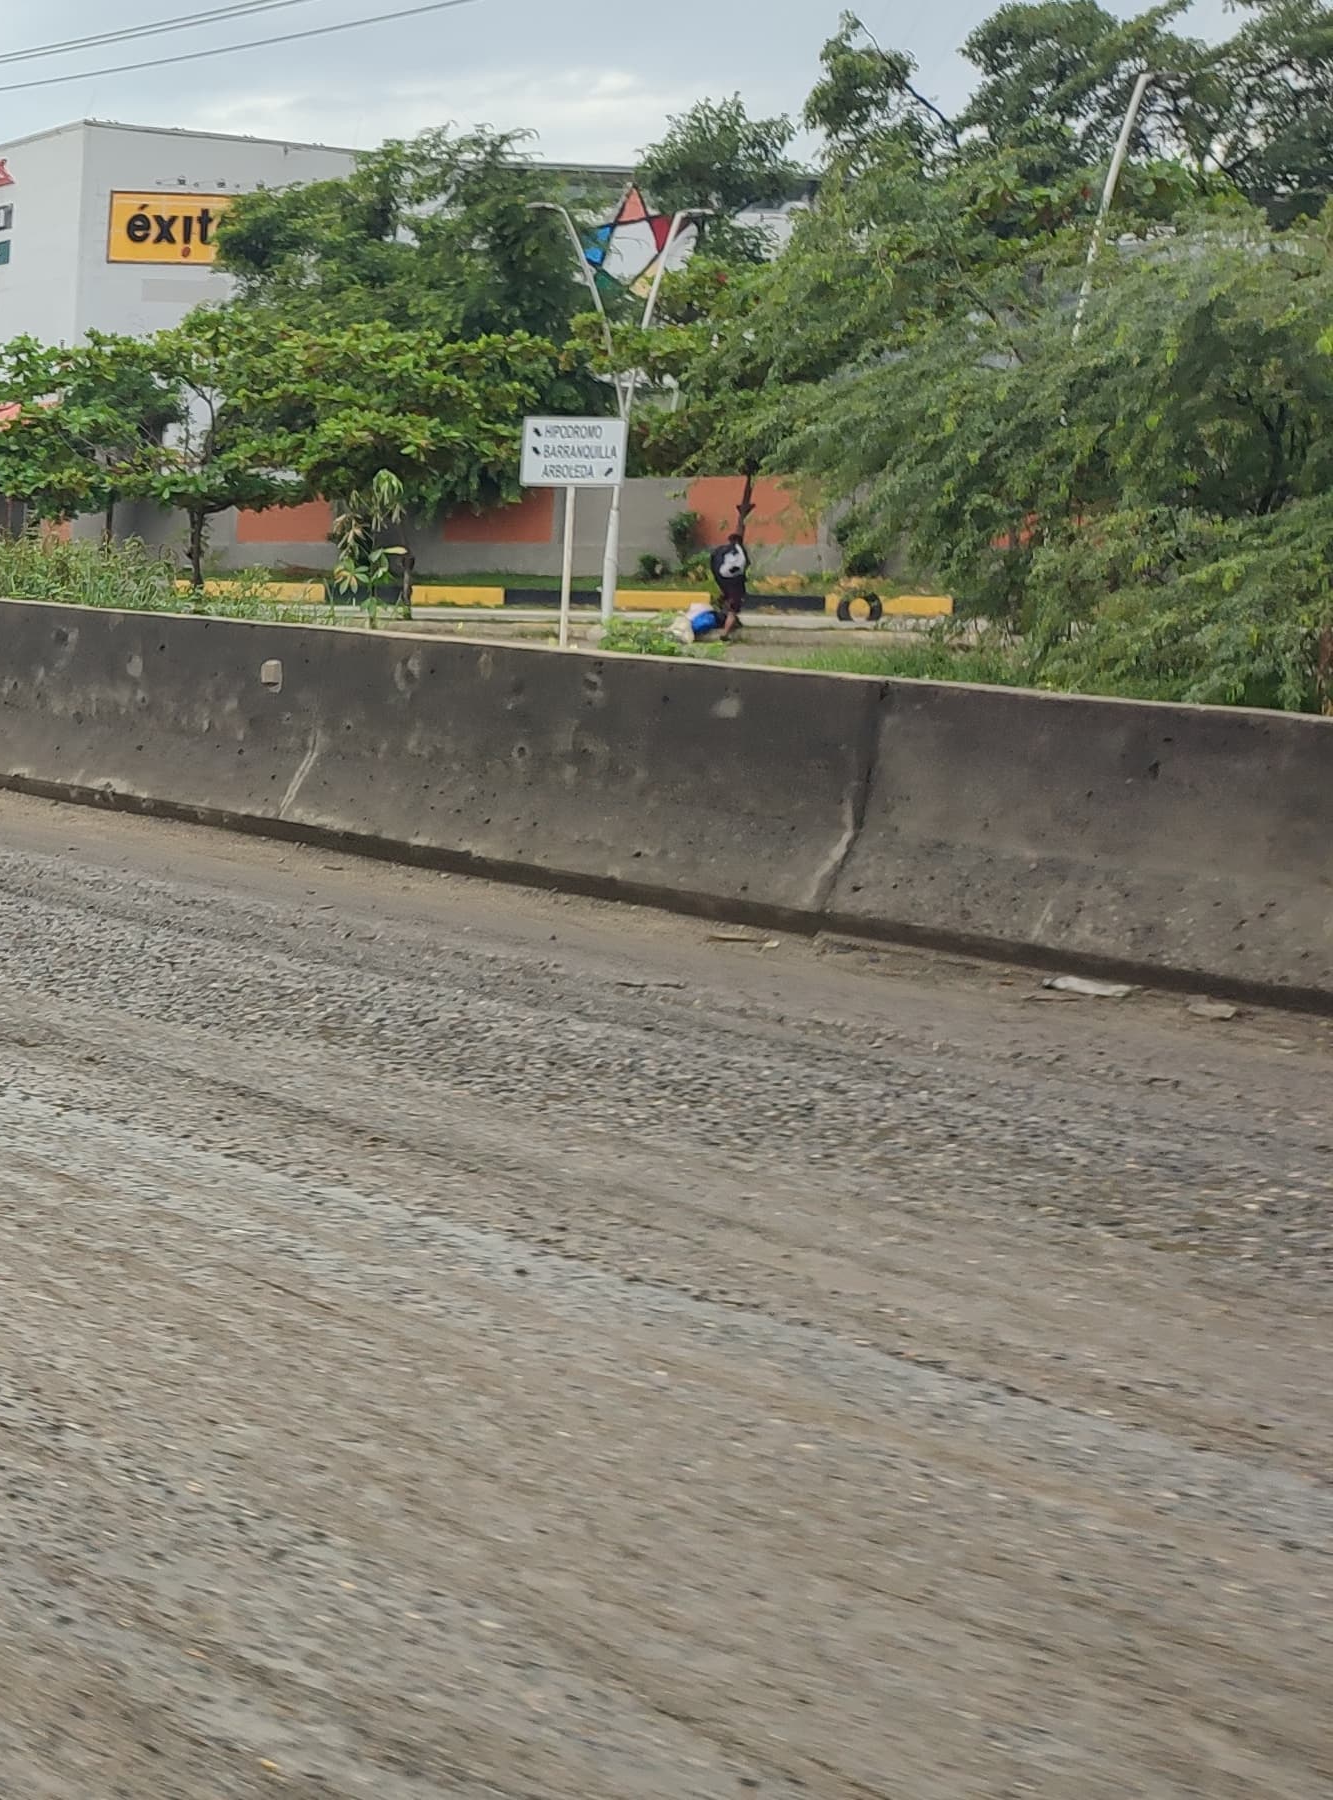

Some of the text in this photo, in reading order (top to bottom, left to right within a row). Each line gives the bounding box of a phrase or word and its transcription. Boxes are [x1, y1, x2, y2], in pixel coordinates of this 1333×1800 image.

[127, 204, 224, 258] éxit
[544, 425, 603, 439] HIPODROMO
[543, 444, 617, 459] BARRANQUILLA
[541, 464, 595, 478] ARBOLEDA
